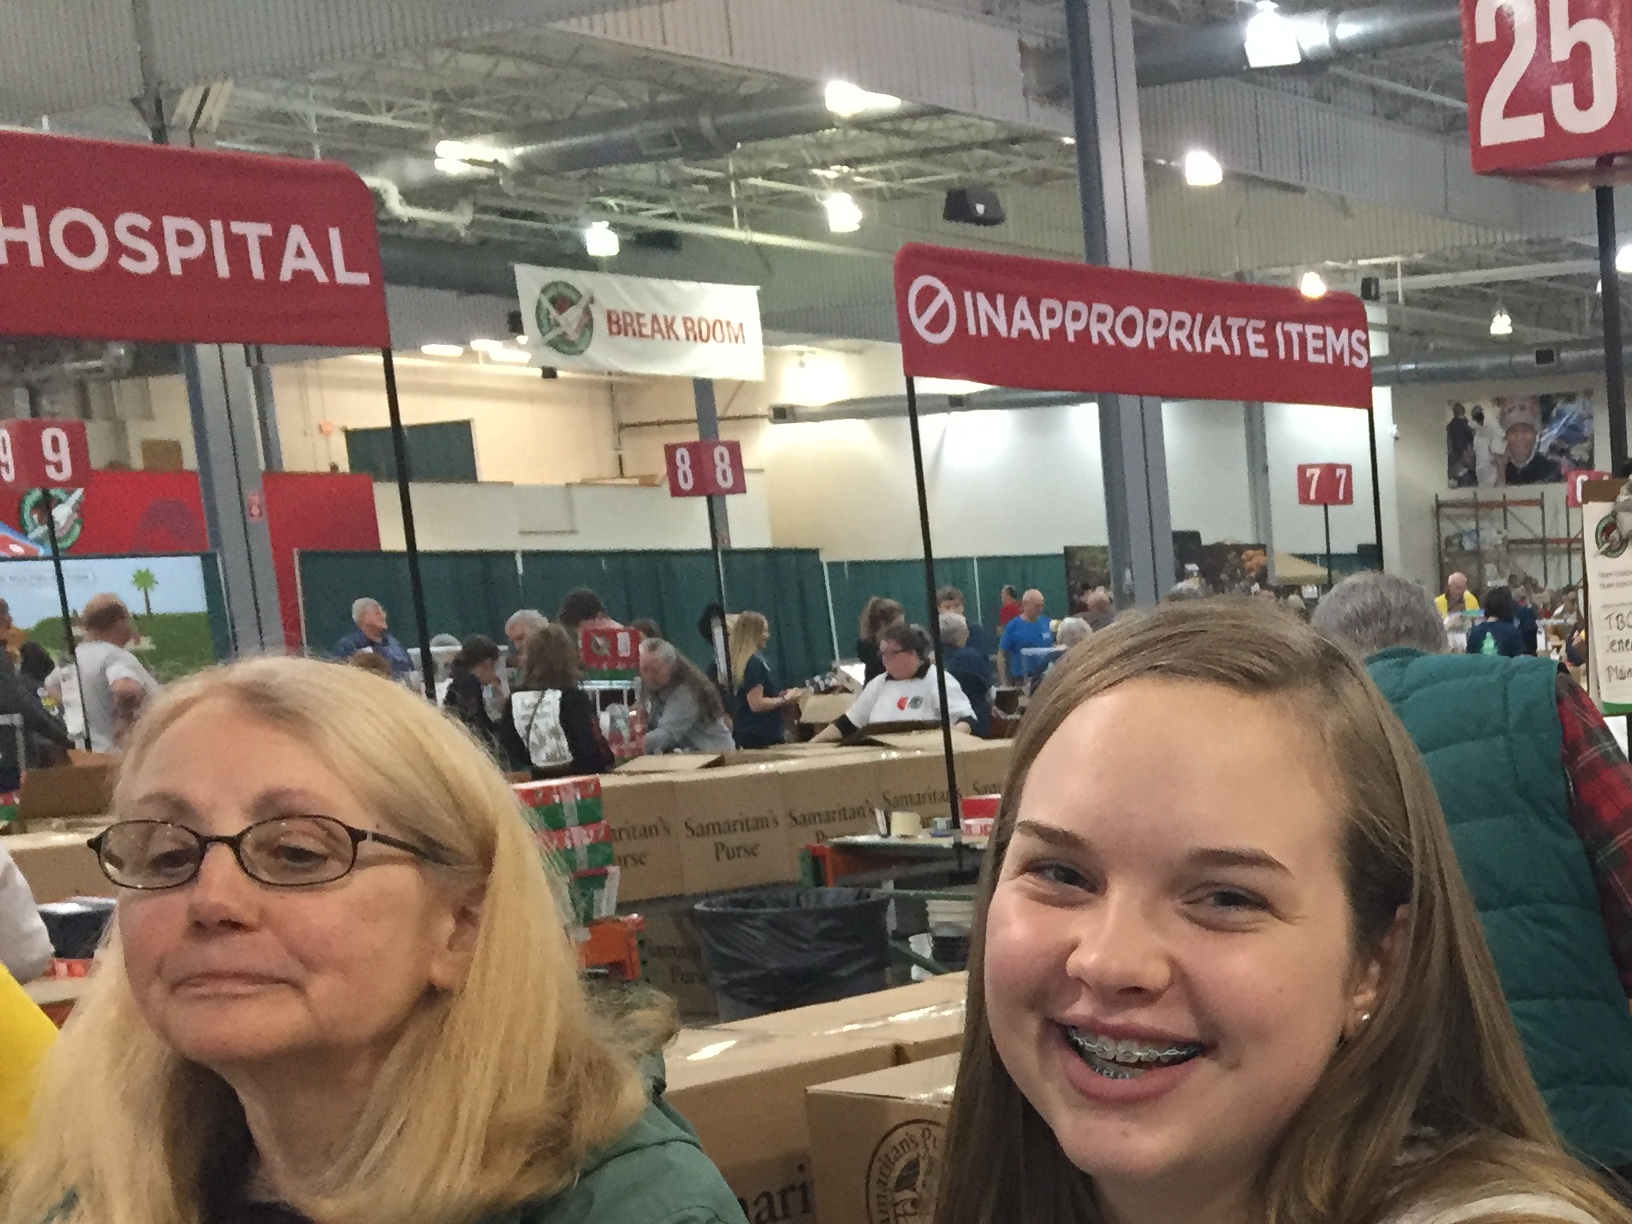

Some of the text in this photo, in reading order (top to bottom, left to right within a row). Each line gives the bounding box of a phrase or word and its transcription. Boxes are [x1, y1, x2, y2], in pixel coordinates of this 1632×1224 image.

[1475, 0, 1618, 146] 25
[0, 203, 371, 286] HOSPITAL
[606, 308, 746, 345] BREAK ROOM
[963, 290, 1369, 369] INAPPROPRIATE ITEMS
[41, 427, 72, 481] 9
[675, 447, 694, 491] 8
[713, 445, 734, 489] 8
[1305, 468, 1321, 500] 7
[1335, 468, 1347, 501] 7
[684, 808, 779, 838] Samaritan's
[714, 841, 761, 862] Purse
